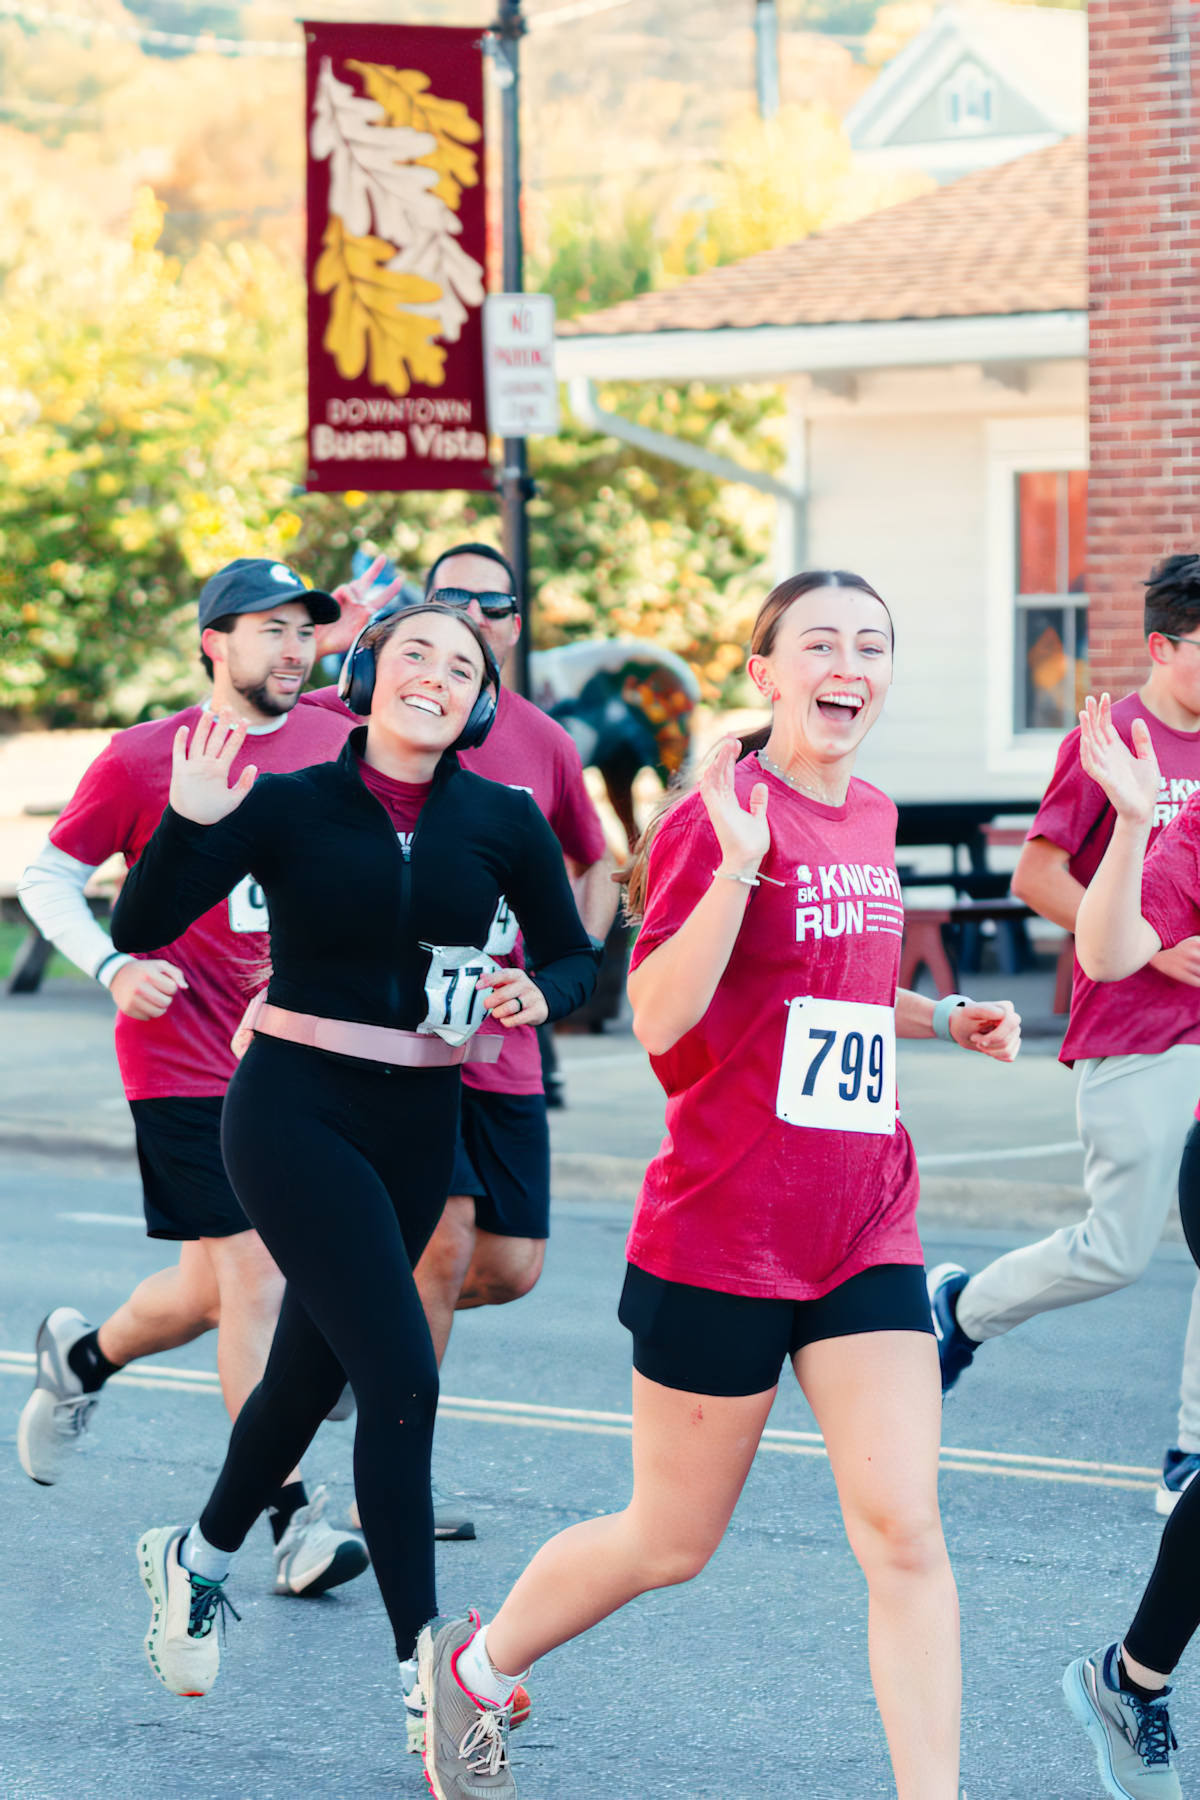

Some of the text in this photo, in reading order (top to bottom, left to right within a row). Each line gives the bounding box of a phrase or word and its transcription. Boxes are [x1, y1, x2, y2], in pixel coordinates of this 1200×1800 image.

[328, 398, 472, 425] DOWNTOWN
[313, 424, 487, 461] Buena Vista
[795, 900, 864, 942] RUN
[801, 1028, 883, 1103] 799
